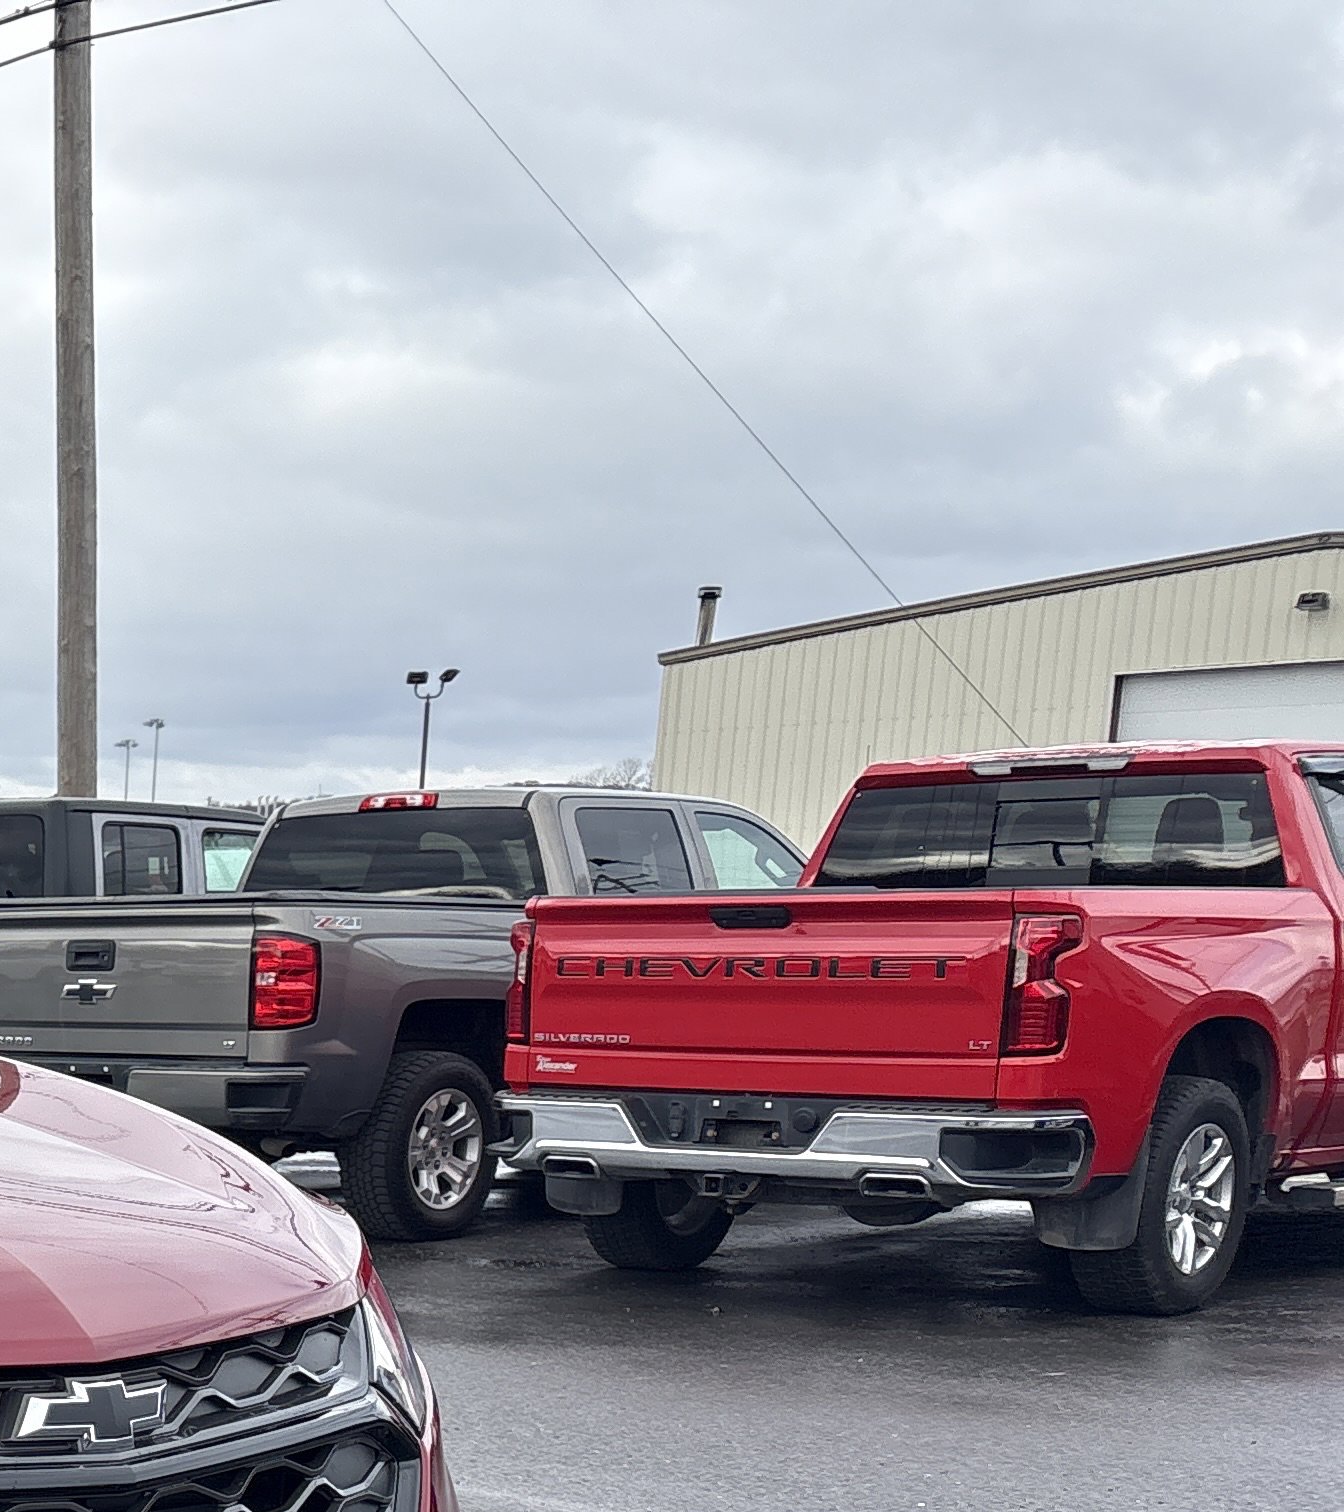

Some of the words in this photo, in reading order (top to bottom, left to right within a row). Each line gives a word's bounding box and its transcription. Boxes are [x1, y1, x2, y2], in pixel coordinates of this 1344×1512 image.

[556, 956, 967, 979] CHEVROLET
[534, 1032, 631, 1044] SILVERADO
[968, 1040, 992, 1050] LT
